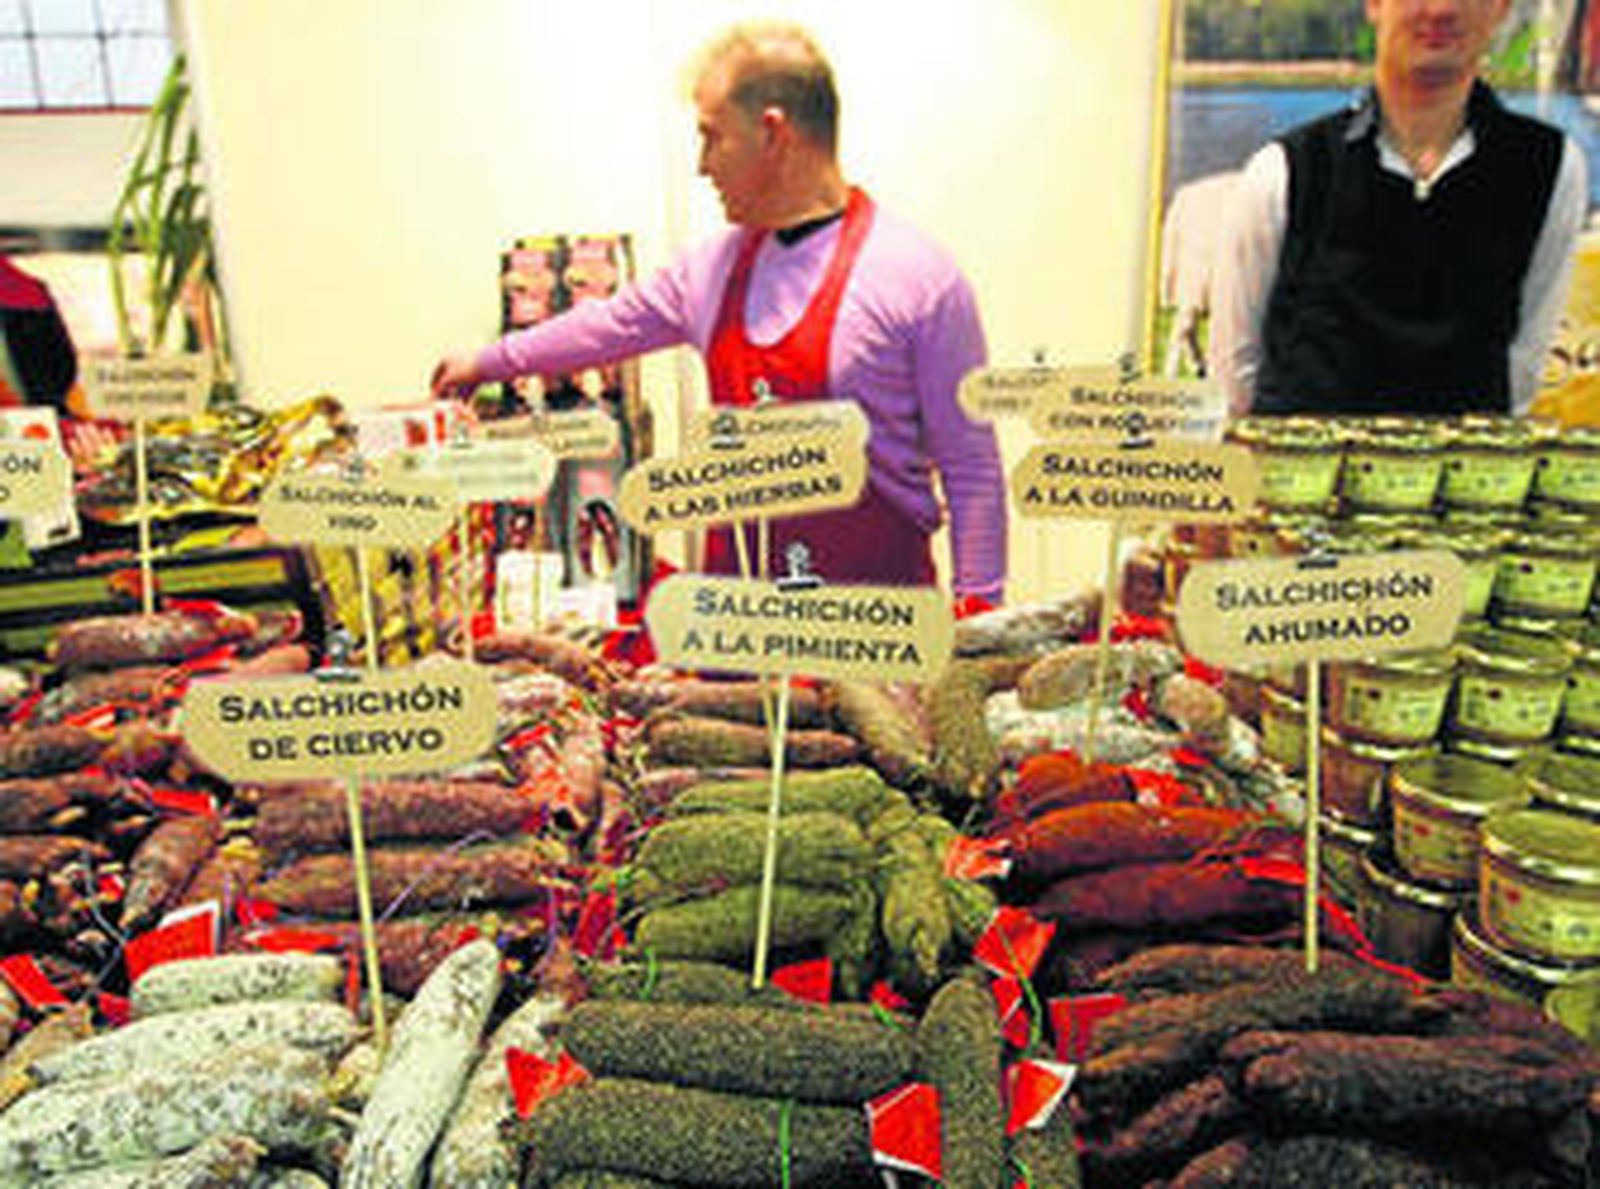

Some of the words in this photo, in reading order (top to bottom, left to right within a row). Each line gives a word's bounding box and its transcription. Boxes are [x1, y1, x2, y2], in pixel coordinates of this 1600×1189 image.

[649, 445, 827, 493] SALCHICHÓN
[1043, 453, 1223, 483] SALCHICHÓN
[280, 485, 406, 508] SALCHICHÓN
[644, 504, 662, 524] A
[667, 494, 720, 519] LAS
[725, 472, 843, 509] HIERBAS
[1025, 485, 1042, 504] A
[1050, 486, 1084, 507] LA
[1091, 489, 1234, 513] GUINDILLA
[694, 587, 913, 626] SALCHICHÓN
[1216, 571, 1433, 611] SALCHICHÓN
[1245, 612, 1412, 645] AHUMADO
[682, 630, 703, 651] A
[714, 631, 756, 654] LA
[763, 633, 921, 666] PIMIENTA
[218, 683, 463, 723] SALCHICHÓN
[248, 735, 298, 760] DE
[306, 727, 444, 757] CIERVO
